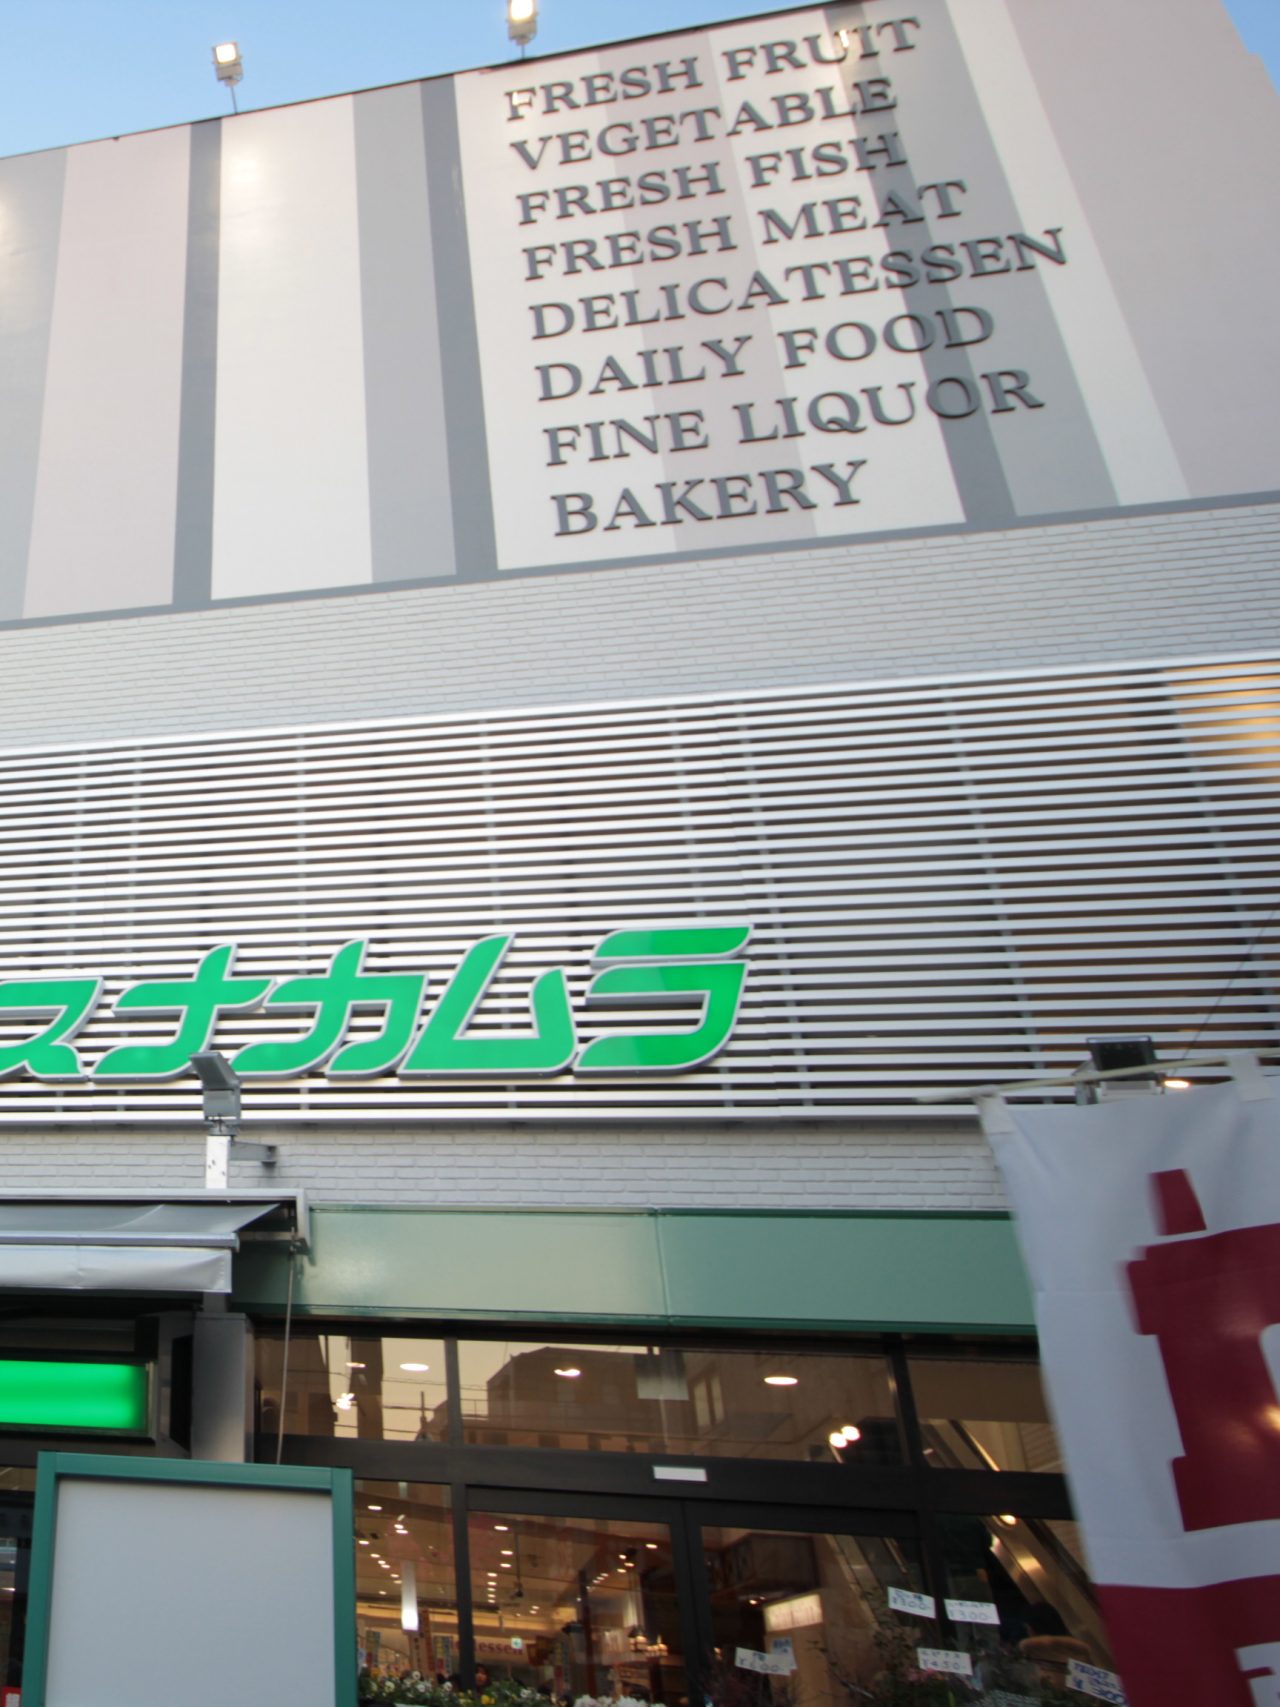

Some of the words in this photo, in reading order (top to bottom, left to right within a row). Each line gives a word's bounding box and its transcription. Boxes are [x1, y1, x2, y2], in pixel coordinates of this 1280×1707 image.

[505, 57, 703, 121] FRESH
[722, 17, 921, 82] FRUIT
[510, 76, 898, 171] VEGETABLE
[517, 161, 725, 225] FRESH
[745, 131, 908, 190] FISH
[522, 215, 738, 281] FRESH
[758, 179, 968, 246] MEAT
[529, 227, 1068, 341] DELICATESSEN
[535, 335, 752, 402] DAILY
[778, 305, 995, 370] FOOD
[543, 409, 709, 467] FINE
[732, 369, 1045, 446] LIQUOR
[550, 459, 868, 537] BAKERY
